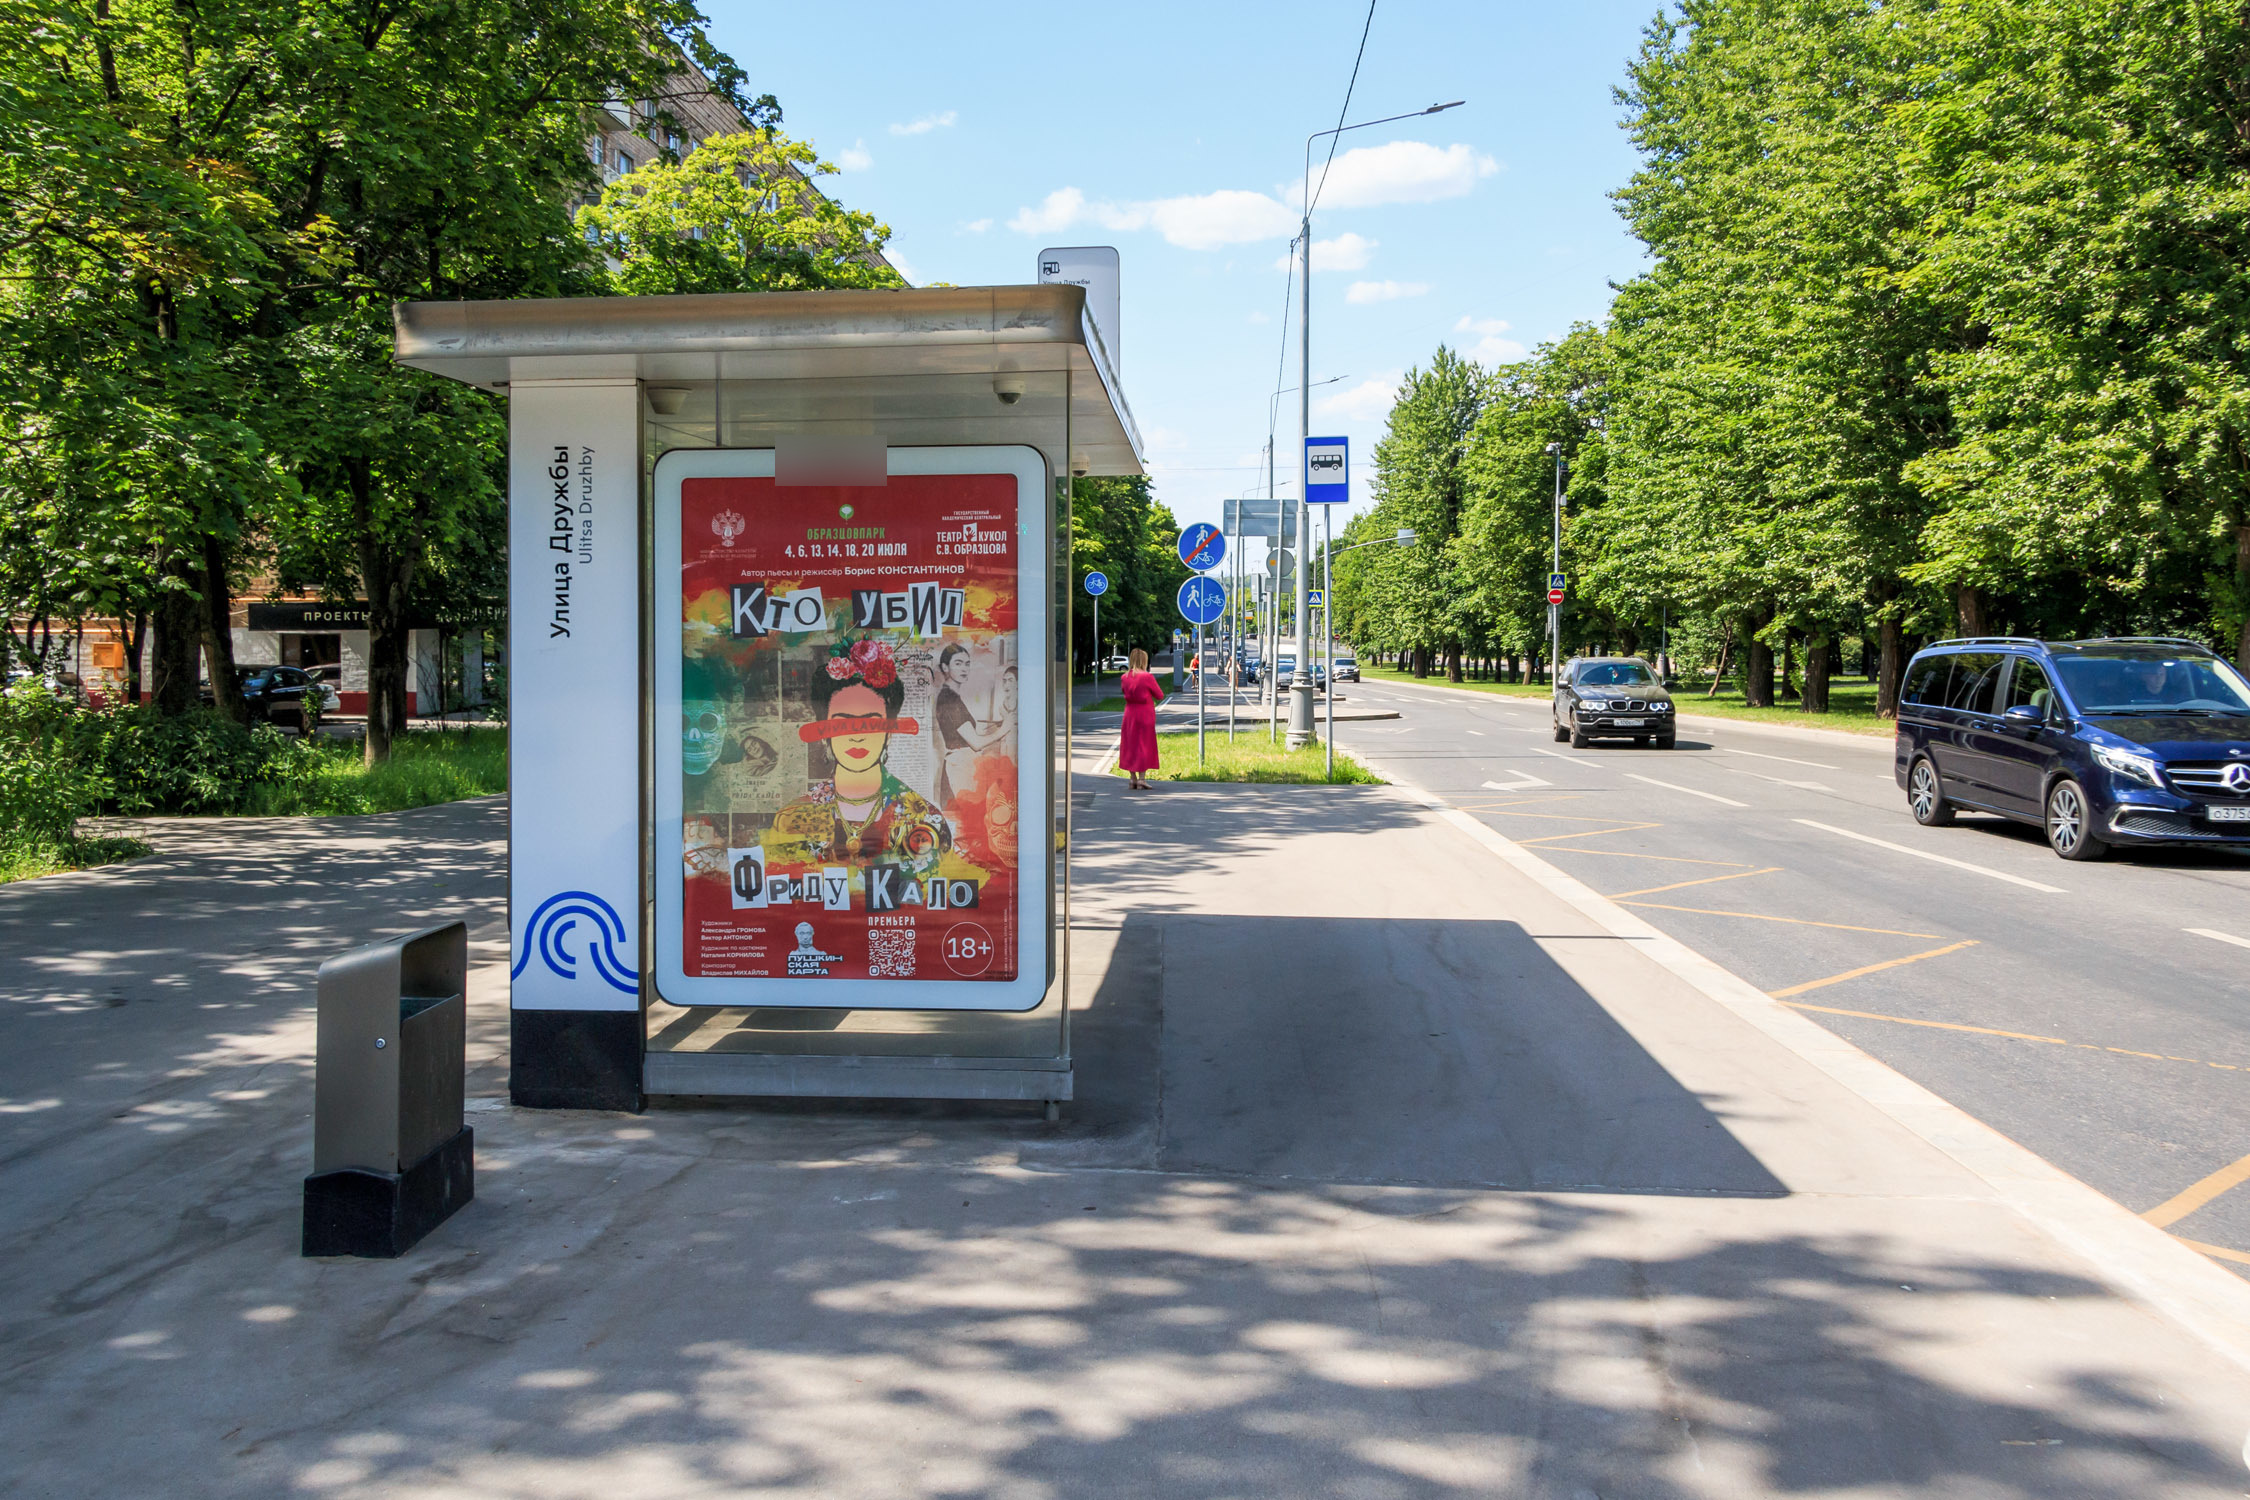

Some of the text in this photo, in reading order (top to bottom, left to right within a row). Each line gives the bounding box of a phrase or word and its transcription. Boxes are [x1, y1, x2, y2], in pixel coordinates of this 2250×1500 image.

[578, 446, 595, 564] Ulitsa Druzhby
[807, 528, 885, 540] ОБРАЗЦОВПАРК
[936, 531, 1007, 542] ТЕАТР КУКОЛ
[548, 446, 573, 638] Улица Дружбы
[862, 544, 874, 556] 20
[878, 543, 907, 556] ИЮЛЯ
[936, 544, 1007, 555] С.В. ОБРАЗЦОВА
[802, 568, 842, 577] режиссёр
[845, 567, 875, 576] Борис
[878, 565, 964, 575] КОНСТАНТИНОВ
[868, 916, 915, 926] ПРЕМЬЕРА
[948, 938, 991, 958] 18+
